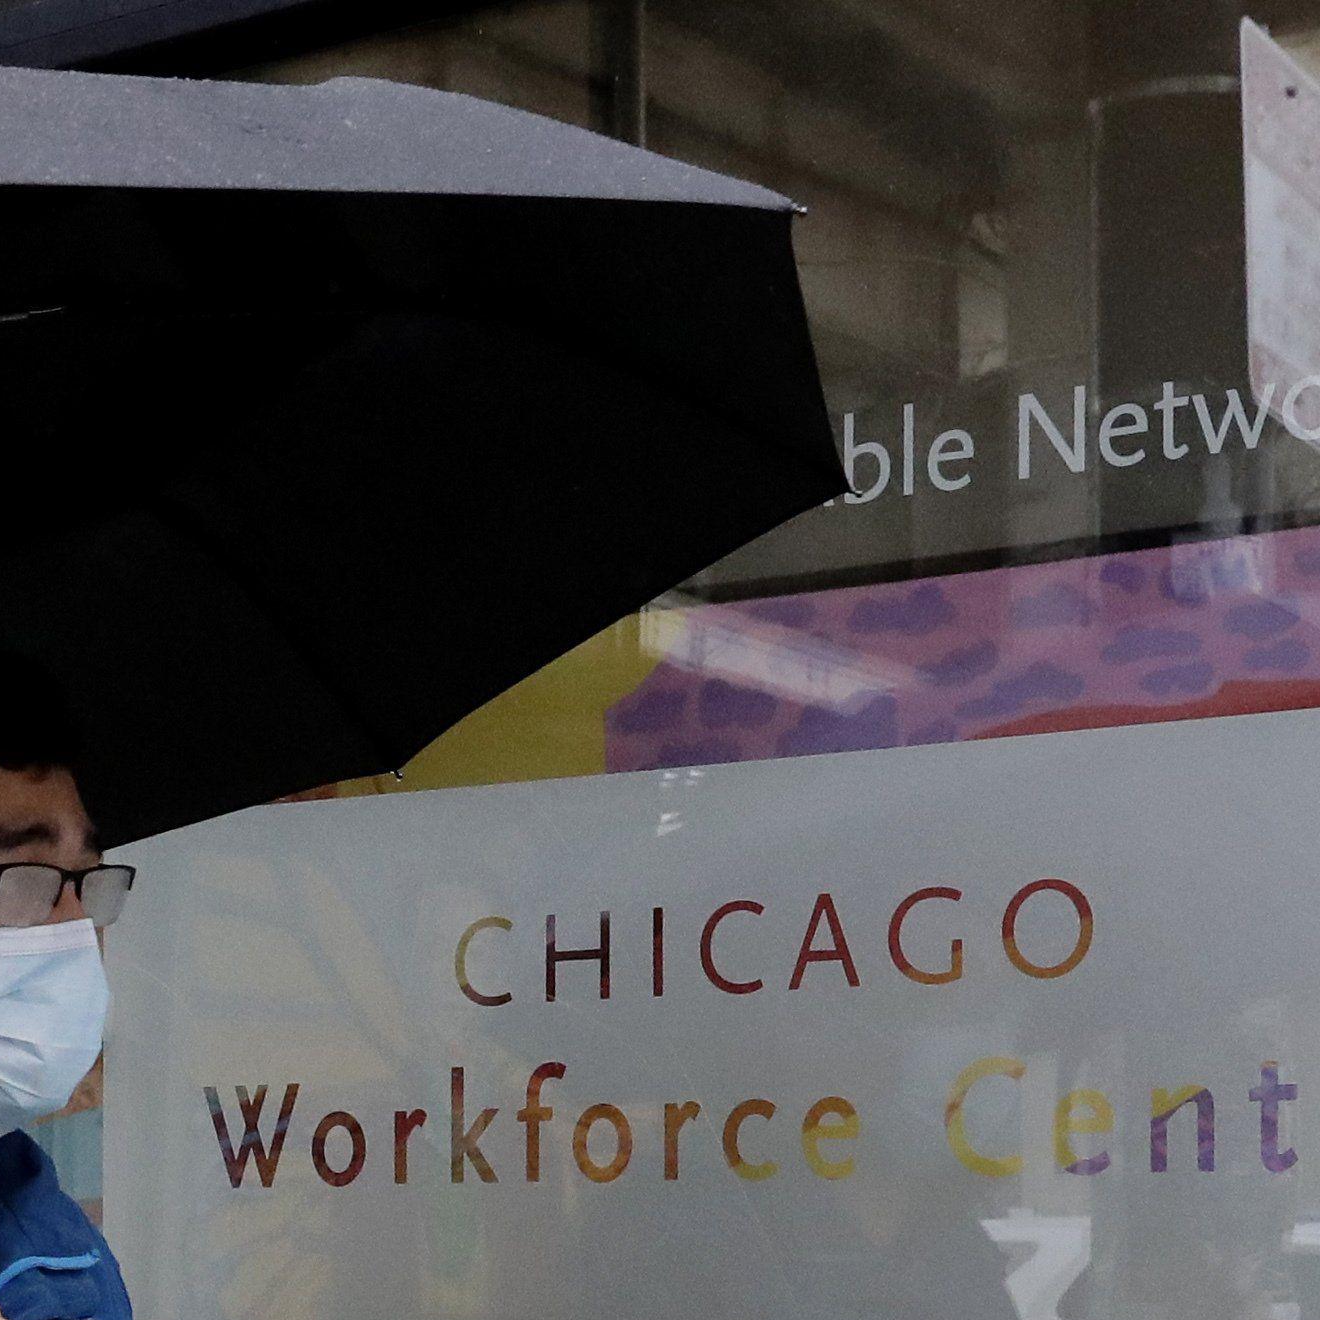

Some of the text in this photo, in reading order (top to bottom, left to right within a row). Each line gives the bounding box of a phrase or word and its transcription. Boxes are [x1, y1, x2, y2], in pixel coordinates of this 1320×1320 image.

[826, 403, 974, 507] ble
[455, 877, 1094, 1008] CHICAGO
[203, 1061, 860, 1188] Workforce
